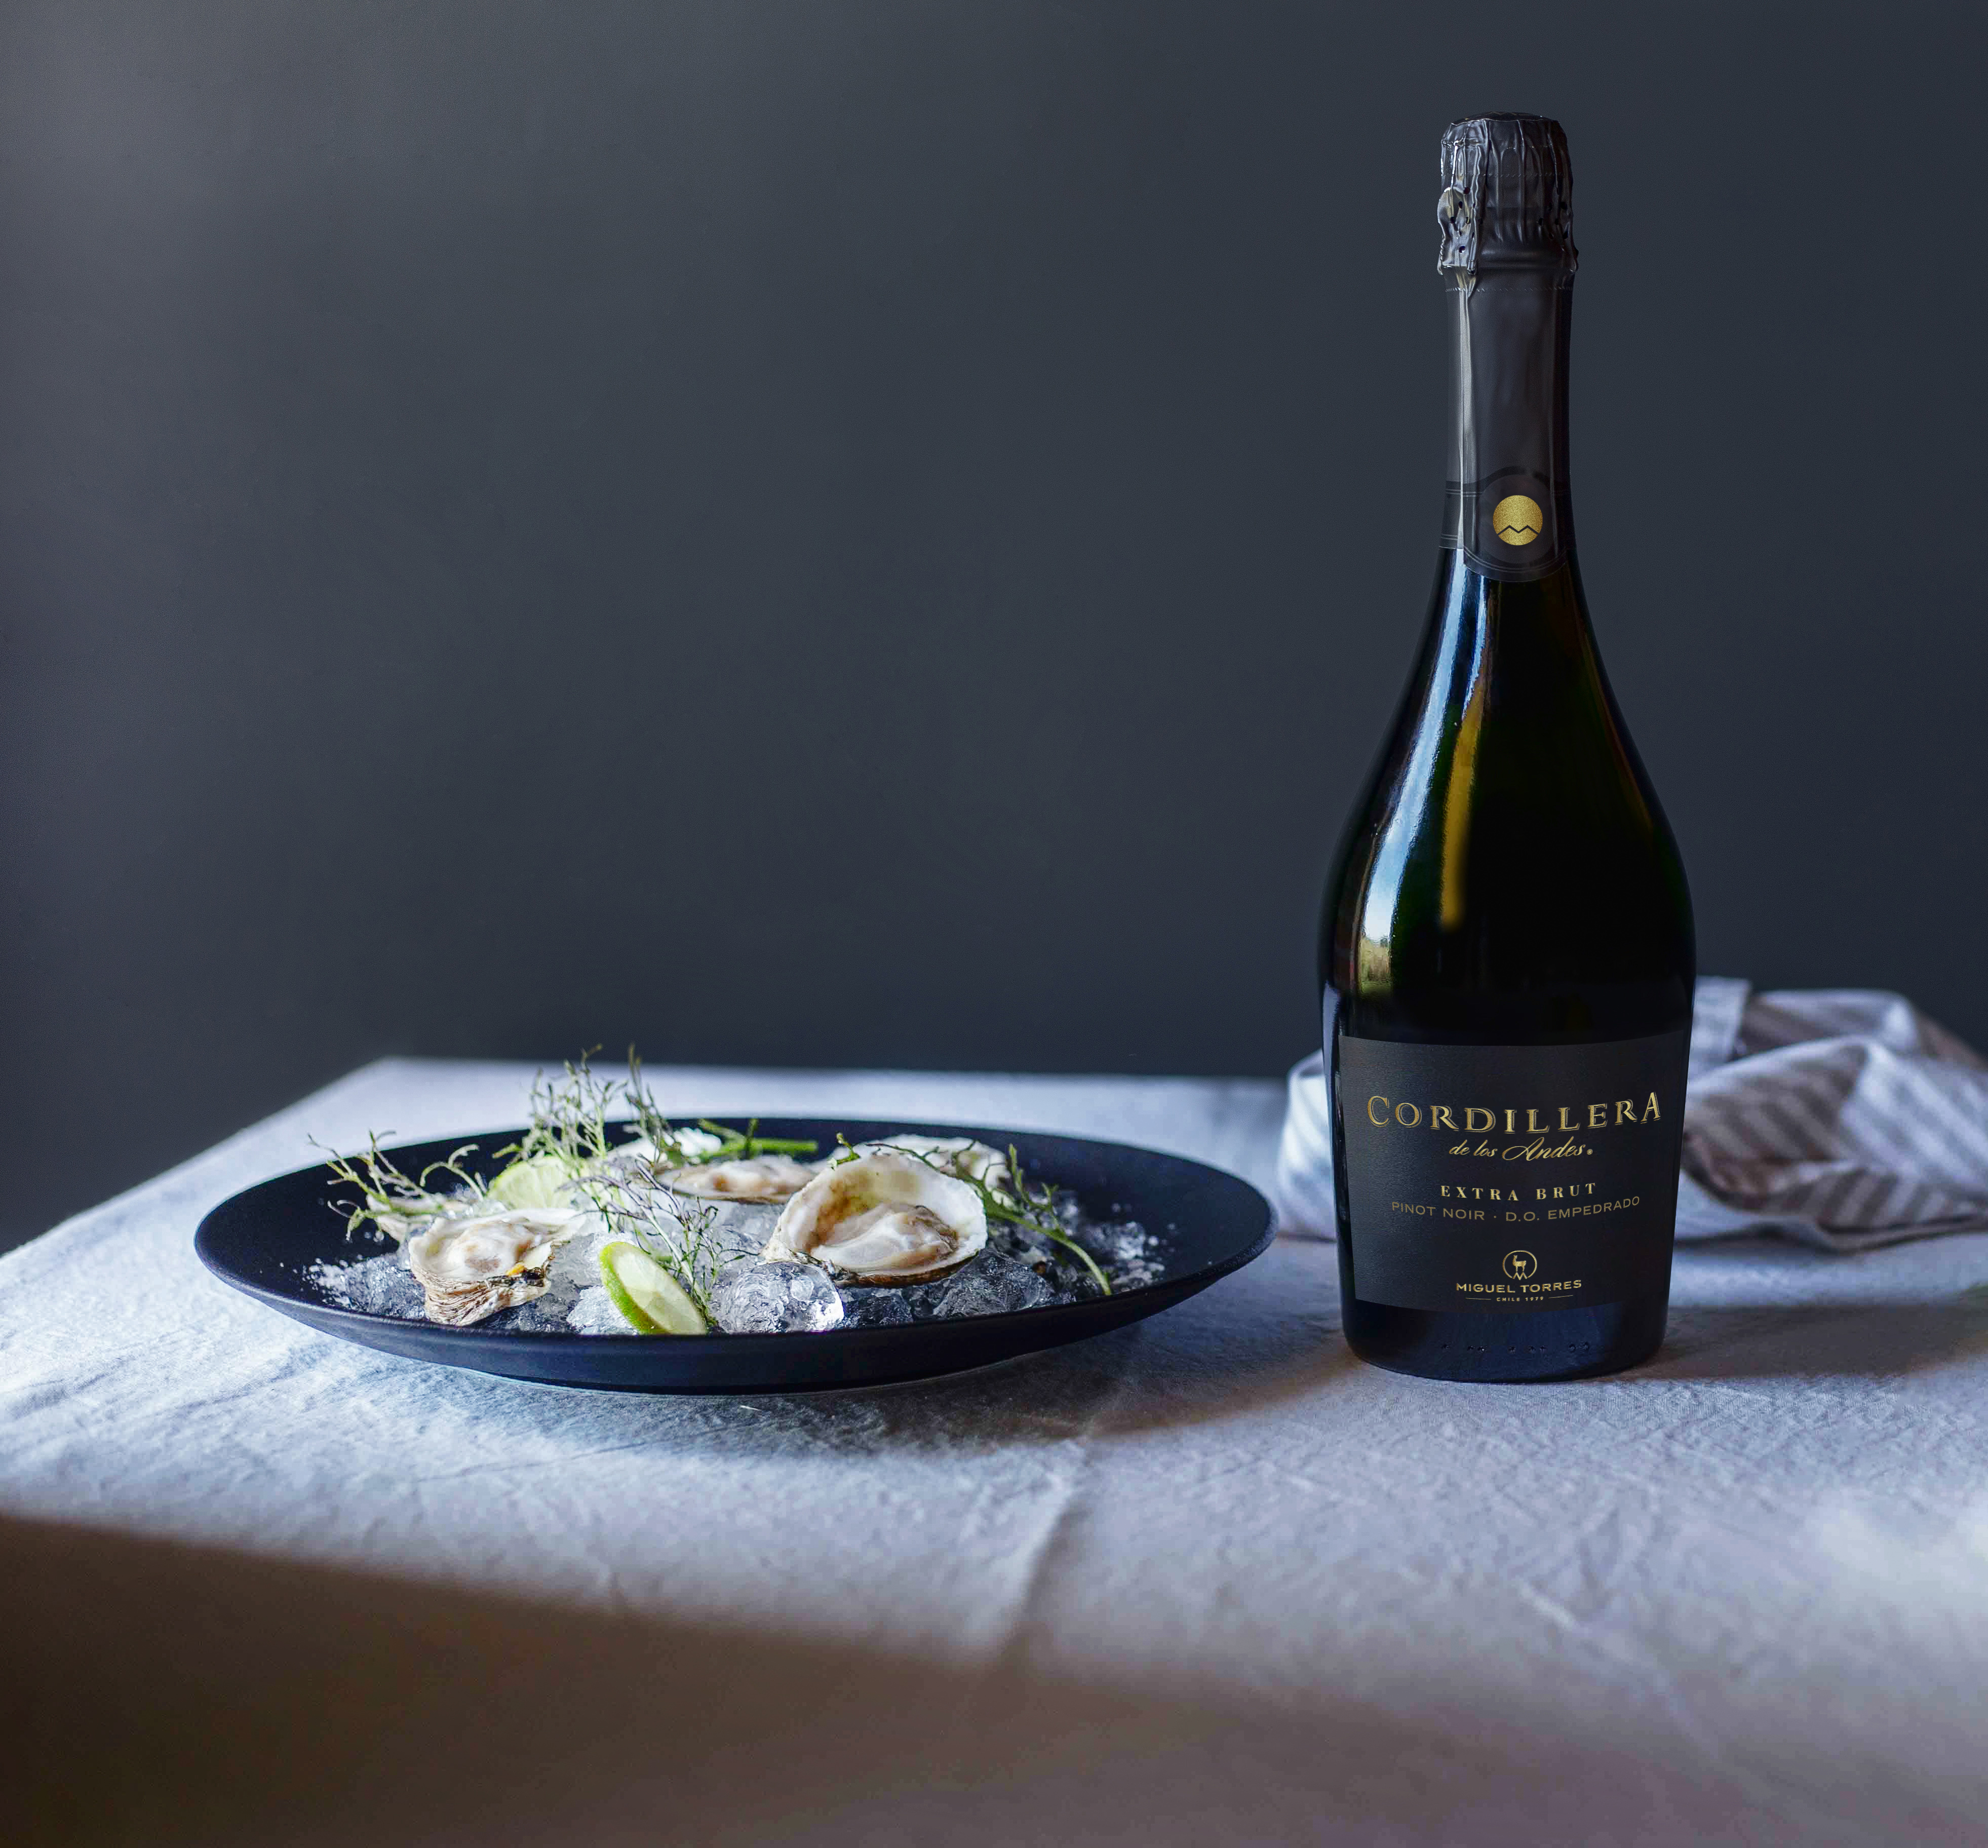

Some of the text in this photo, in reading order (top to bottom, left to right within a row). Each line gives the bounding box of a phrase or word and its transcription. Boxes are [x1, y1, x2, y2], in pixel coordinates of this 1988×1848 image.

[1367, 1092, 1661, 1134] CORDILLERA
[1449, 1139, 1470, 1156] de
[1473, 1139, 1498, 1157] los
[1440, 1183, 1595, 1201] EXTRA BRUT
[1392, 1201, 1436, 1216] PINOT
[1443, 1208, 1485, 1220] NOIR
[1506, 1211, 1539, 1222] D.O.
[1548, 1196, 1640, 1220] EMPEDRADO
[1456, 1280, 1581, 1293] MIGUEL TORRES
